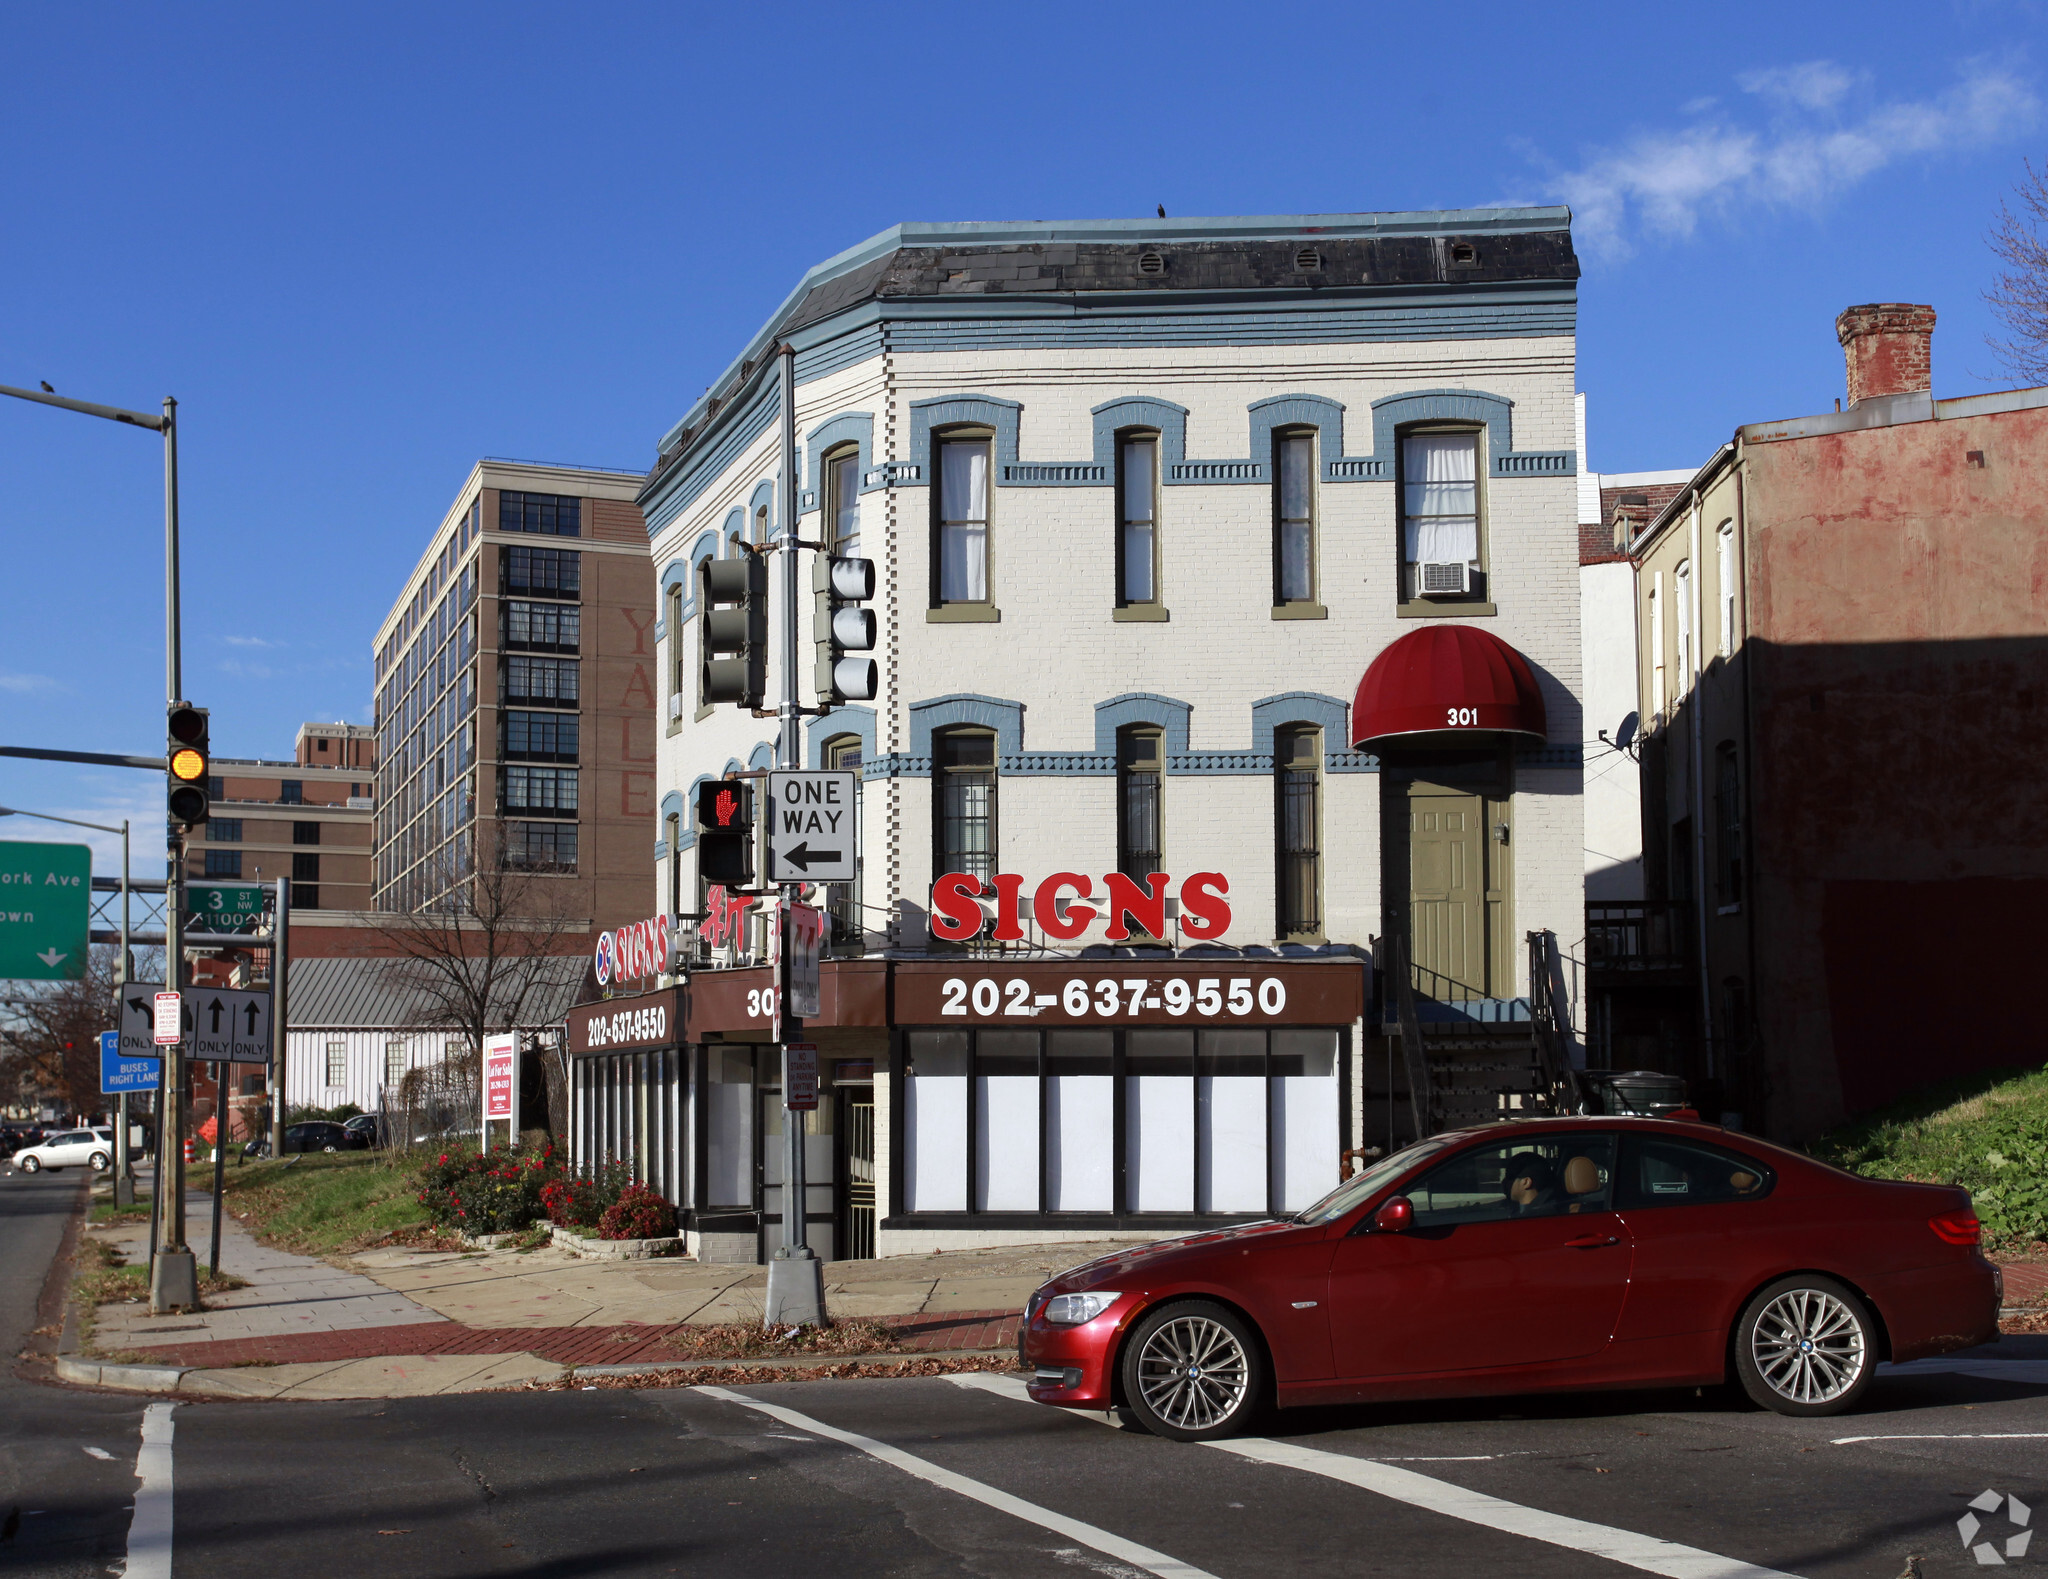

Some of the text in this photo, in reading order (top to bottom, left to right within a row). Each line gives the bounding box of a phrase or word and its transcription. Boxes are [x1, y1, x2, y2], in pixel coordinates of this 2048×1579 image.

[620, 608, 656, 816] YALE
[1447, 708, 1478, 725] 301
[785, 781, 841, 804] ONE
[783, 810, 843, 833] WAY
[0, 871, 80, 886] ork Ave
[208, 890, 251, 909] 3 ST
[932, 872, 1232, 941] SIGNS
[0, 911, 33, 922] own
[205, 913, 243, 925] 1100
[615, 914, 668, 982] SIGNS
[747, 987, 782, 1018] 30
[941, 977, 1286, 1016] 202-637-9550
[588, 1005, 666, 1047] 202-637-9550
[122, 1036, 153, 1049] ONLY
[200, 1041, 229, 1053] ONLY
[235, 1043, 265, 1055] ONLY
[798, 1052, 806, 1061] NO
[120, 1062, 148, 1073] BUSES
[790, 1062, 815, 1070] STANDING
[109, 1072, 159, 1085] RIGHT LANE
[797, 1072, 816, 1081] PARKING
[792, 1082, 814, 1091] ANYTIME
